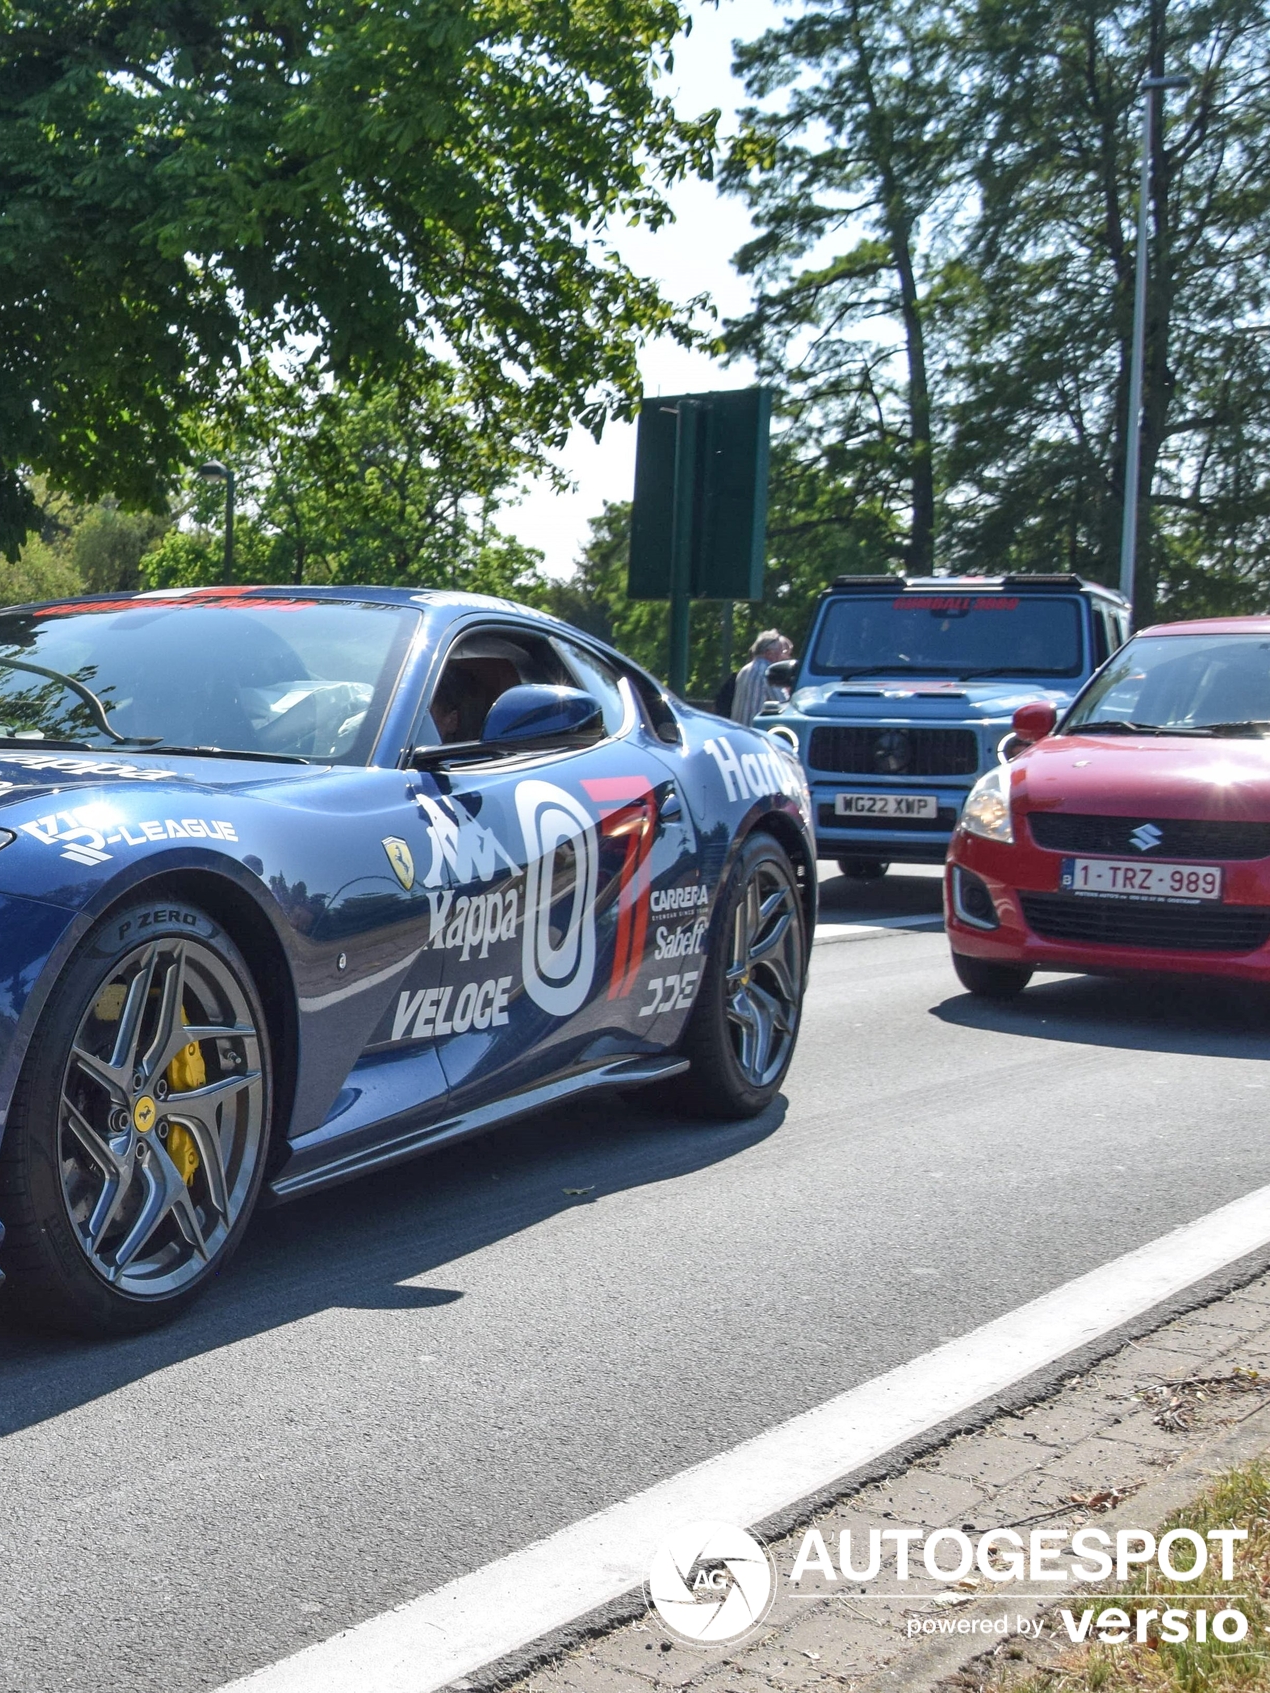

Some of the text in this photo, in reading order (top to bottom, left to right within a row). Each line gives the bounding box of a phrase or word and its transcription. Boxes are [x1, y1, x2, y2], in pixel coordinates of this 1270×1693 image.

[137, 909, 197, 929] ZERO
[650, 884, 709, 912] CARRERA
[426, 888, 517, 961] Kappa
[391, 975, 513, 1041] VELOCE
